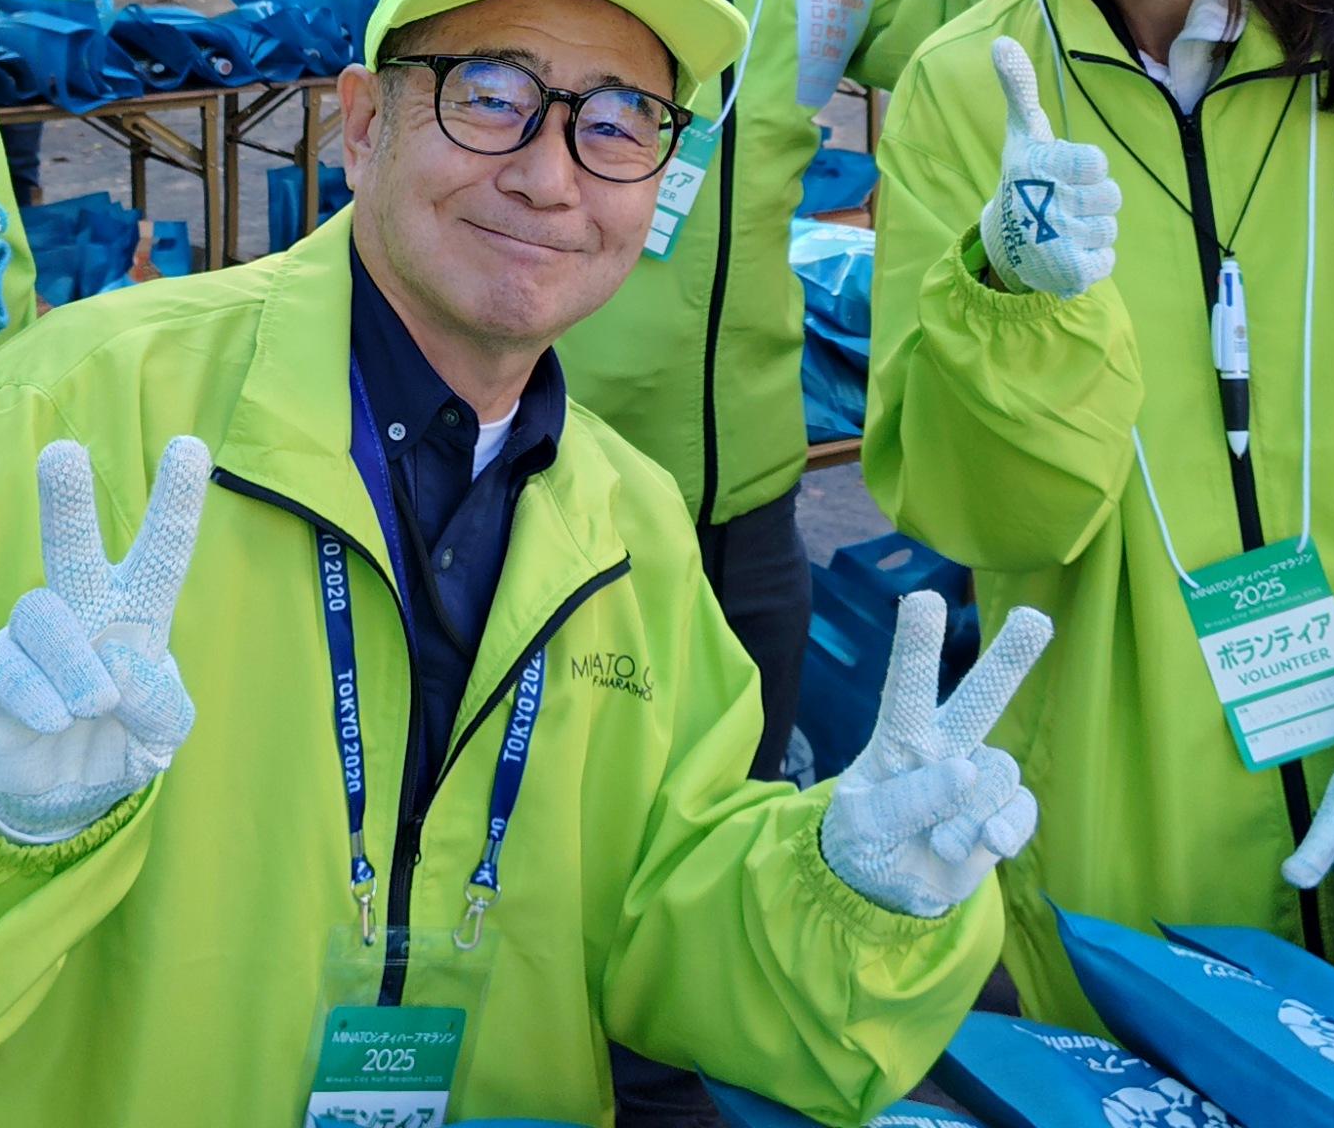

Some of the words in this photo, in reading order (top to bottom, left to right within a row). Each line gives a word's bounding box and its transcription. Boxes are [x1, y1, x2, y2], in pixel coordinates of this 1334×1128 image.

[324, 561, 347, 612] 2020
[1230, 576, 1286, 611] 2025
[1216, 612, 1331, 670] ボランティア
[1237, 646, 1332, 687] VOLUNTEER
[337, 669, 360, 741] TOKYO
[503, 696, 536, 763] TOKYO
[344, 743, 362, 795] 2020
[331, 1030, 456, 1045] MINATOシティハーフマラソン
[362, 1047, 417, 1072] 2025
